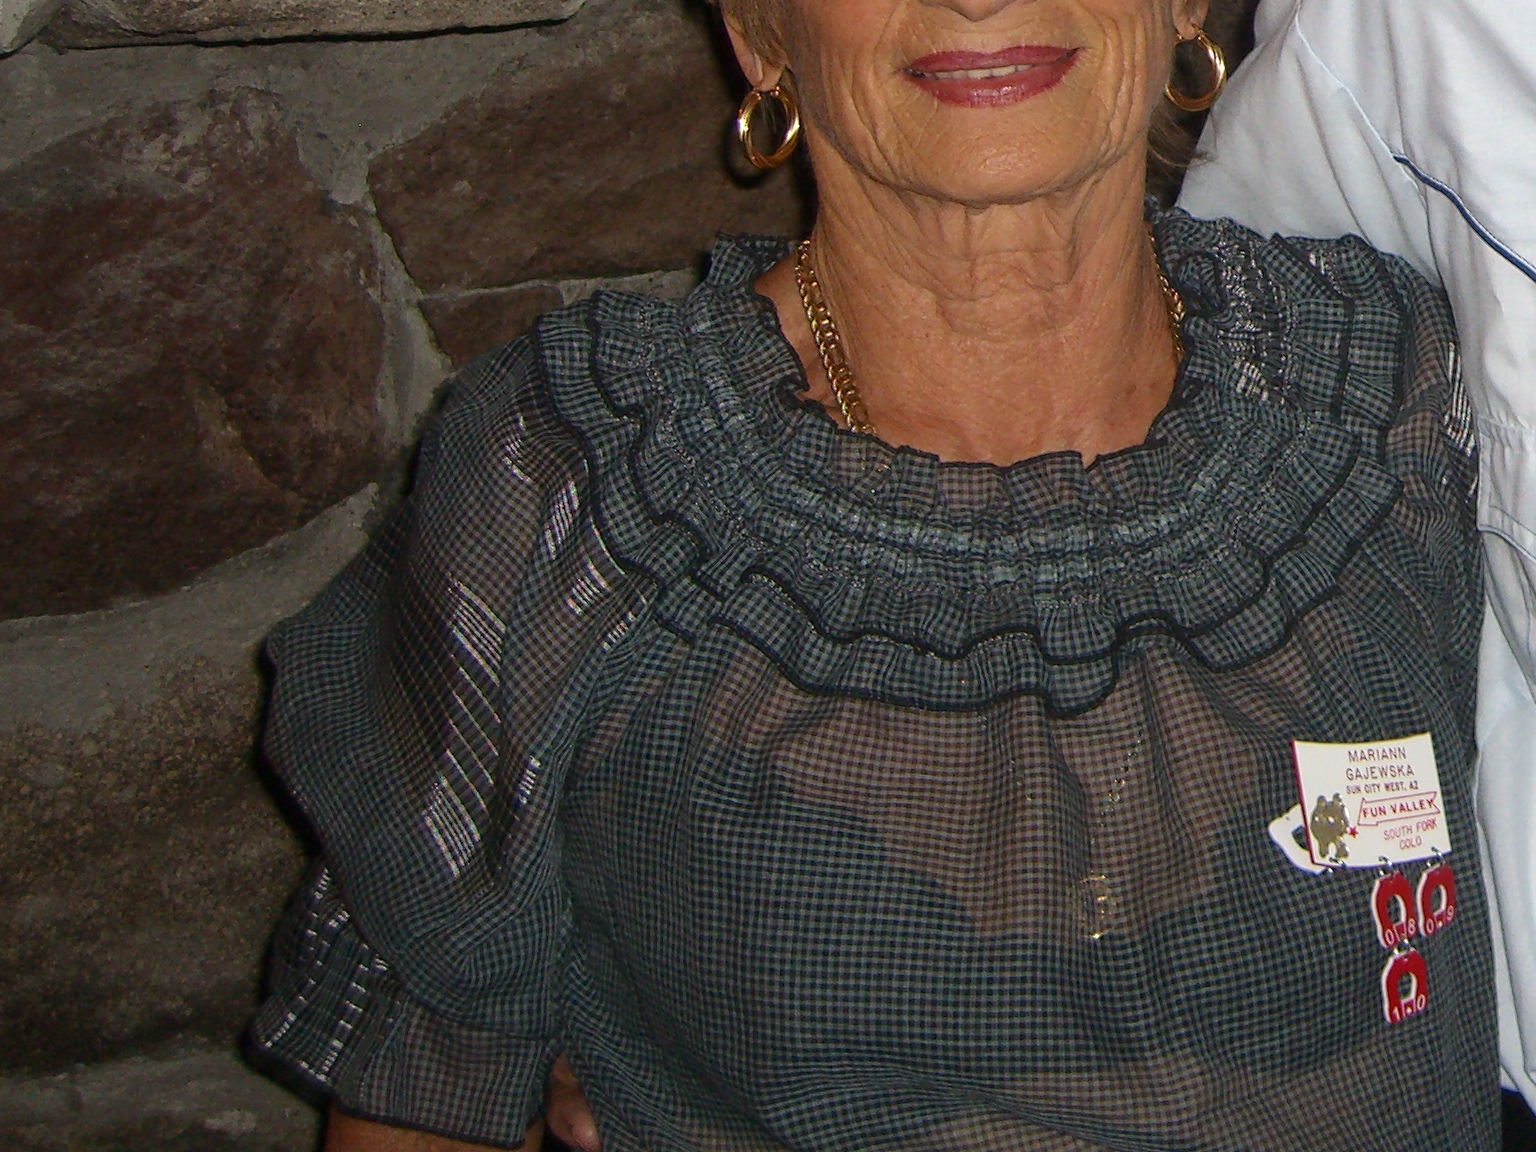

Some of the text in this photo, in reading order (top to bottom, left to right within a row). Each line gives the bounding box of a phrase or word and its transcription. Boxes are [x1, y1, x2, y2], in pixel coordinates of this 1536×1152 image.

[1348, 747, 1407, 763] MARIANN
[1346, 765, 1414, 781] GAJEWSKA
[1346, 785, 1361, 795] SUN
[1364, 783, 1381, 793] CITY
[1409, 780, 1419, 791] AZ
[1363, 798, 1435, 818] FUN VALLEY
[1384, 818, 1437, 840] SOUTH FORK
[1400, 836, 1422, 850] COLO
